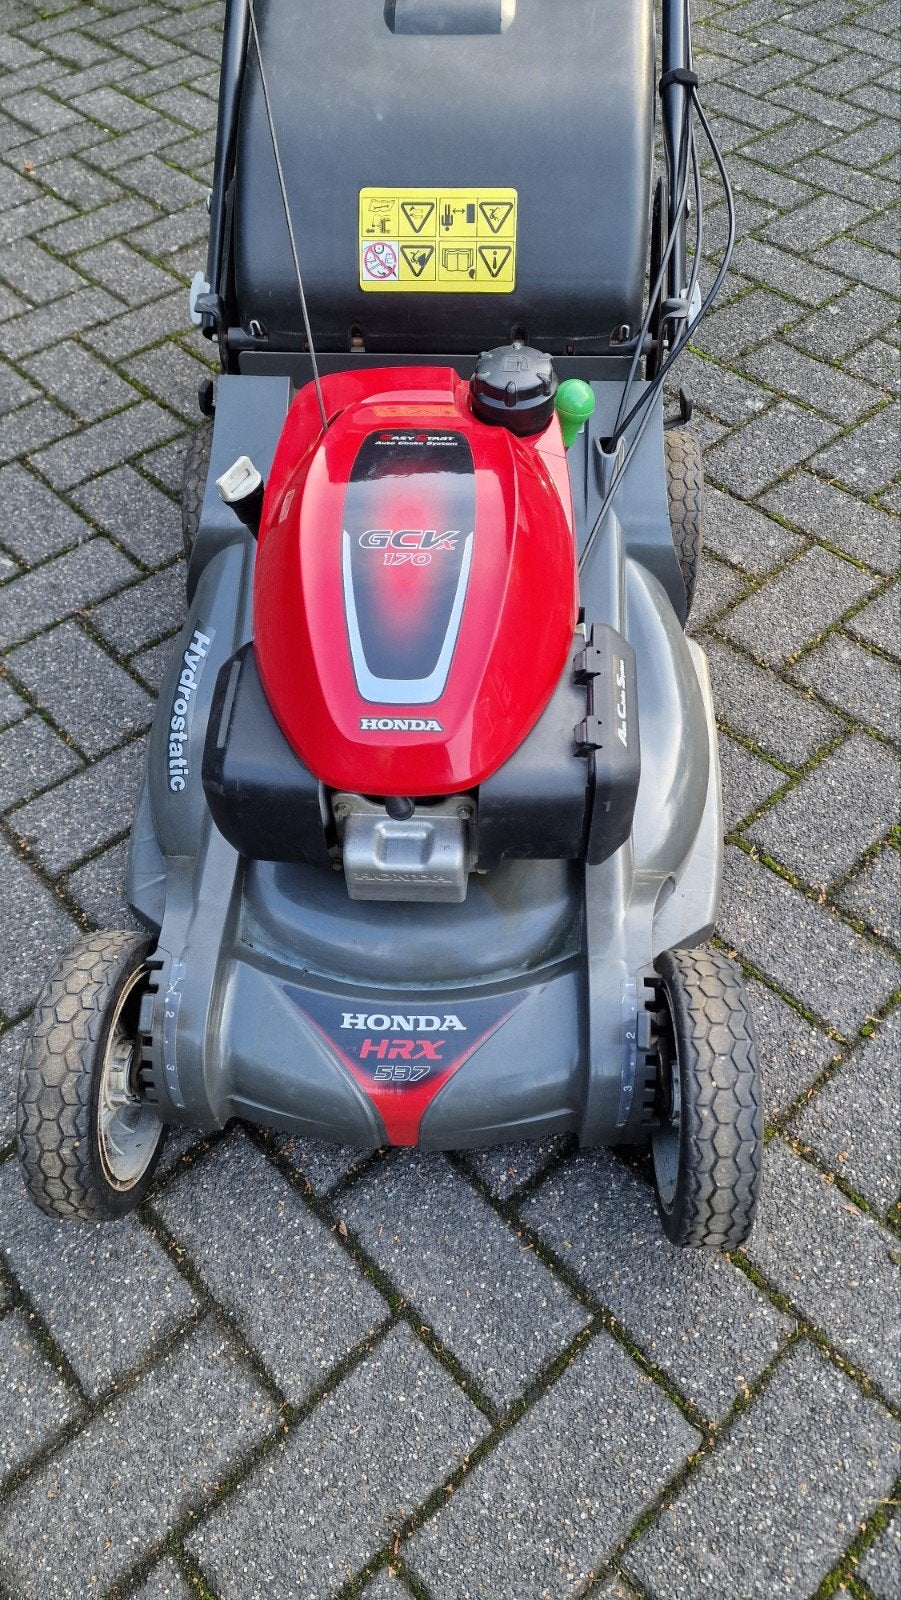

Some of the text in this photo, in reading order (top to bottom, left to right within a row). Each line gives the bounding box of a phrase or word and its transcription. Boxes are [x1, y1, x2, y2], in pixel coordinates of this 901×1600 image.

[382, 552, 432, 566] 170
[168, 629, 211, 792] Hydrostatic
[360, 718, 443, 732] HONDA
[165, 1011, 175, 1019] 2
[340, 1012, 467, 1031] HONDA
[626, 1031, 636, 1039] 2
[359, 1038, 446, 1060] HRX
[166, 1063, 175, 1072] 3
[373, 1065, 431, 1082] 537
[623, 1084, 633, 1092] 3
